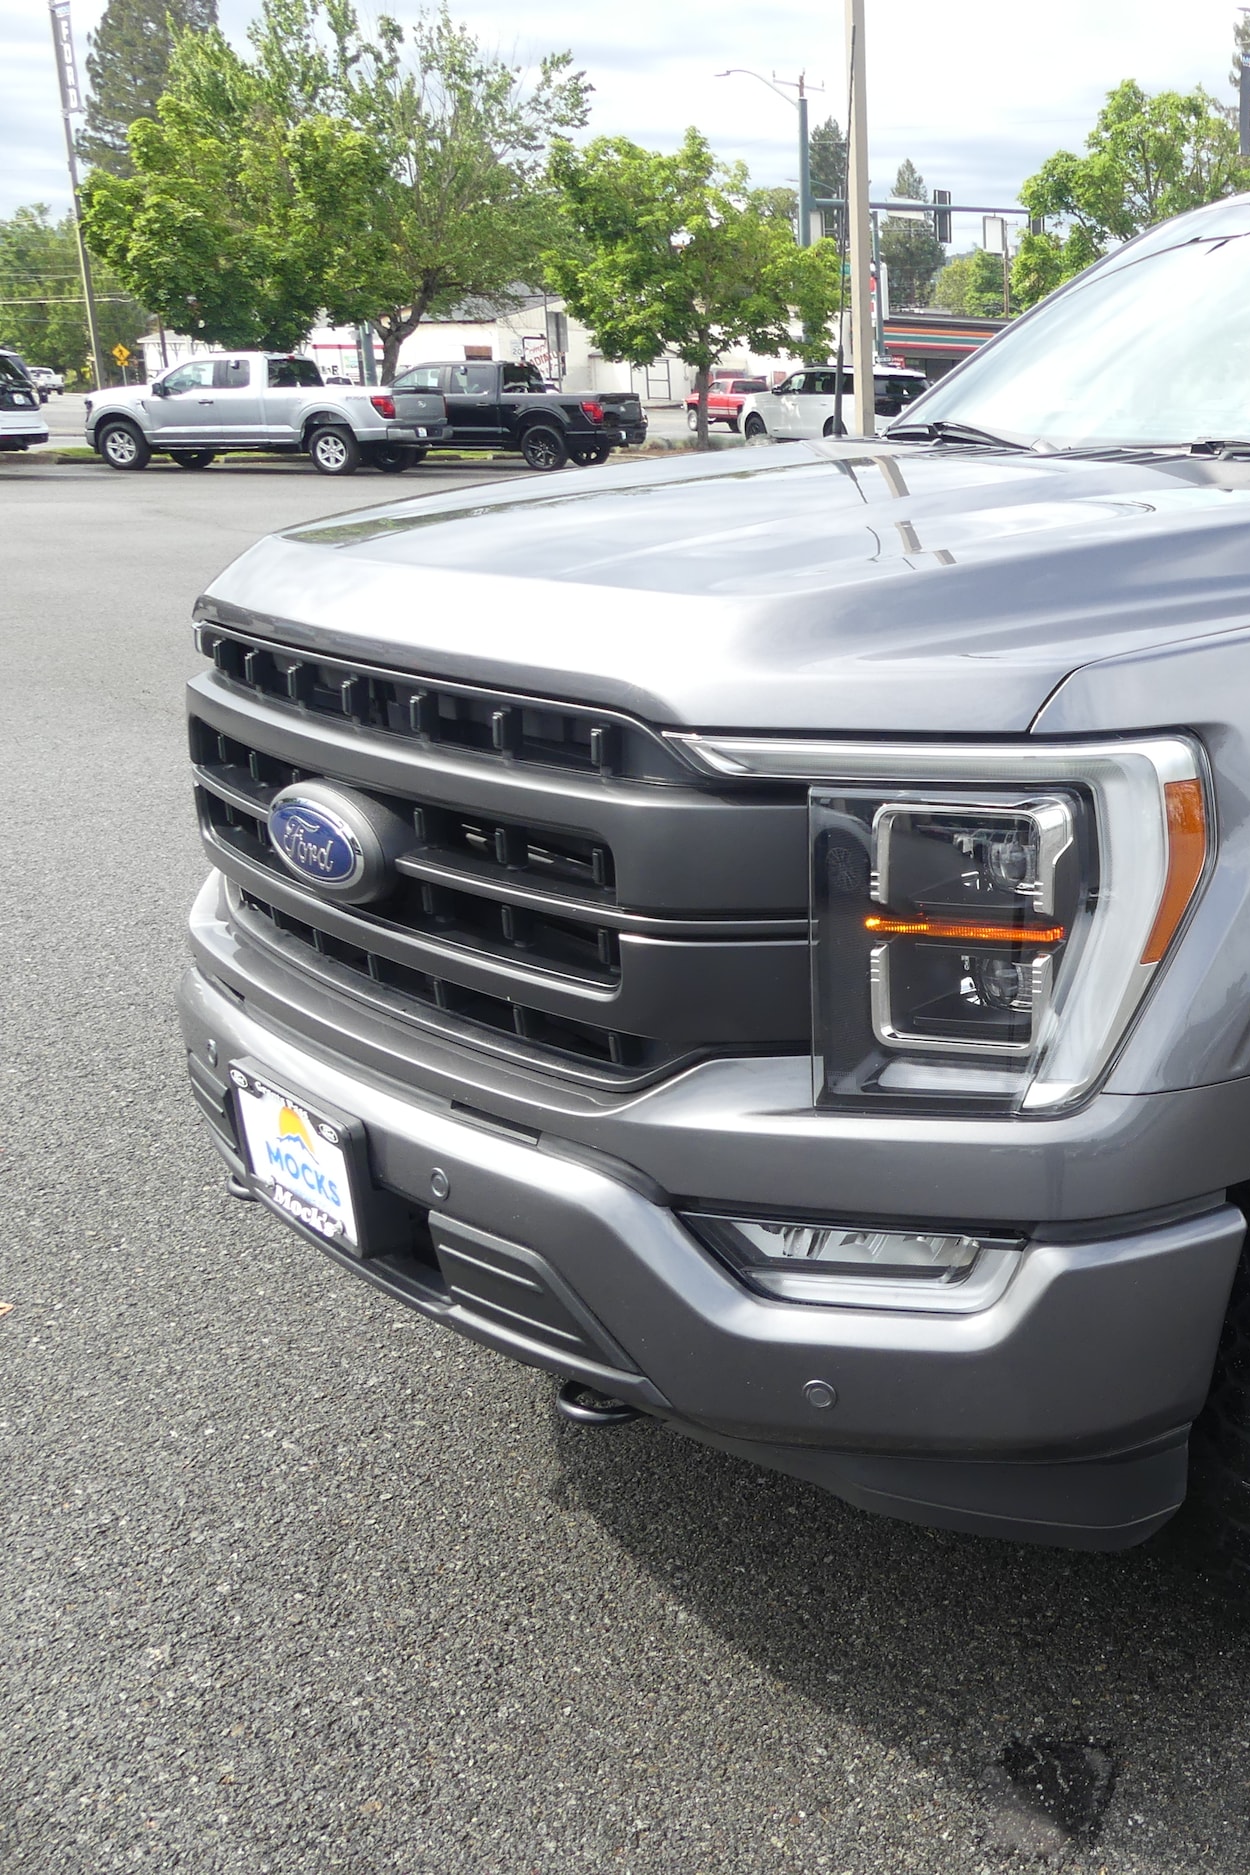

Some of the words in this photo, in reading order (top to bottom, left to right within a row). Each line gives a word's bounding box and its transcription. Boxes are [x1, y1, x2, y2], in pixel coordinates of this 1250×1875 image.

[283, 814, 334, 873] Ford
[264, 1139, 342, 1207] MOCKS
[273, 1183, 338, 1237] Mock's
